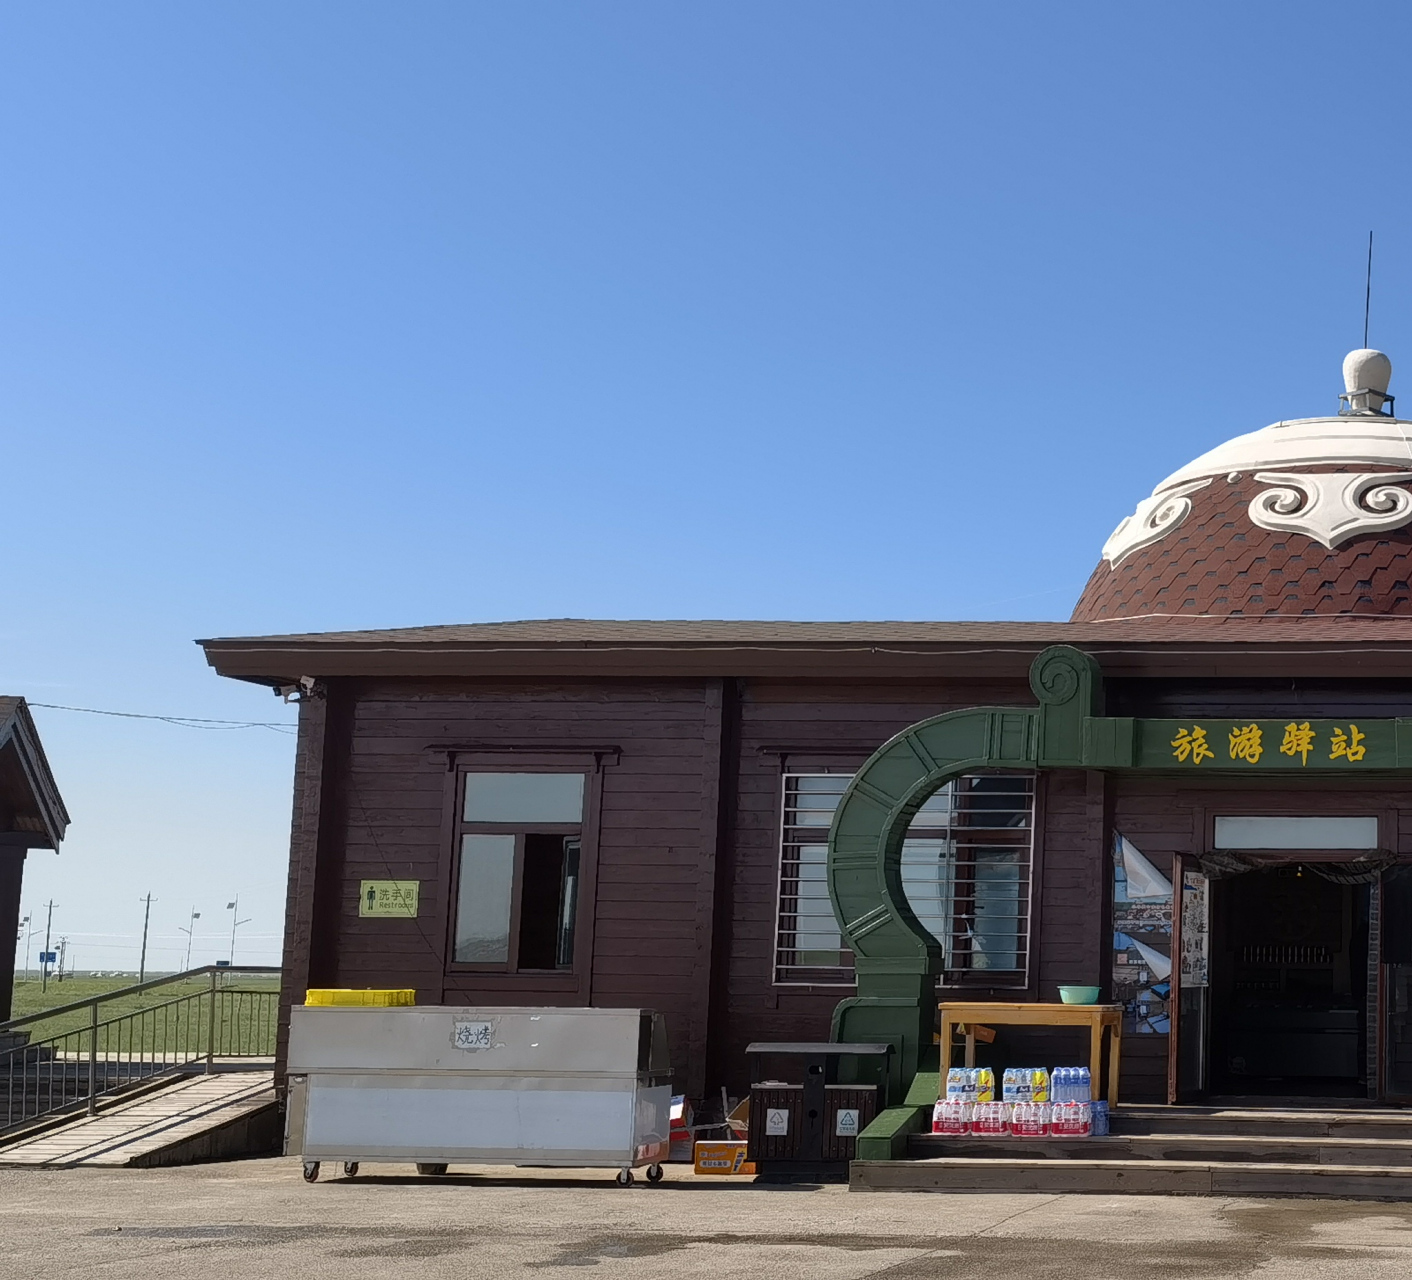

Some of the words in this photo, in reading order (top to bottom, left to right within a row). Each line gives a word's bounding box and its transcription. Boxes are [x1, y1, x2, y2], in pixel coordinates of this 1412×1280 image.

[1171, 722, 1366, 767] 旅游驿站
[379, 888, 414, 901] 洗手间
[456, 1025, 491, 1045] 烧烤
